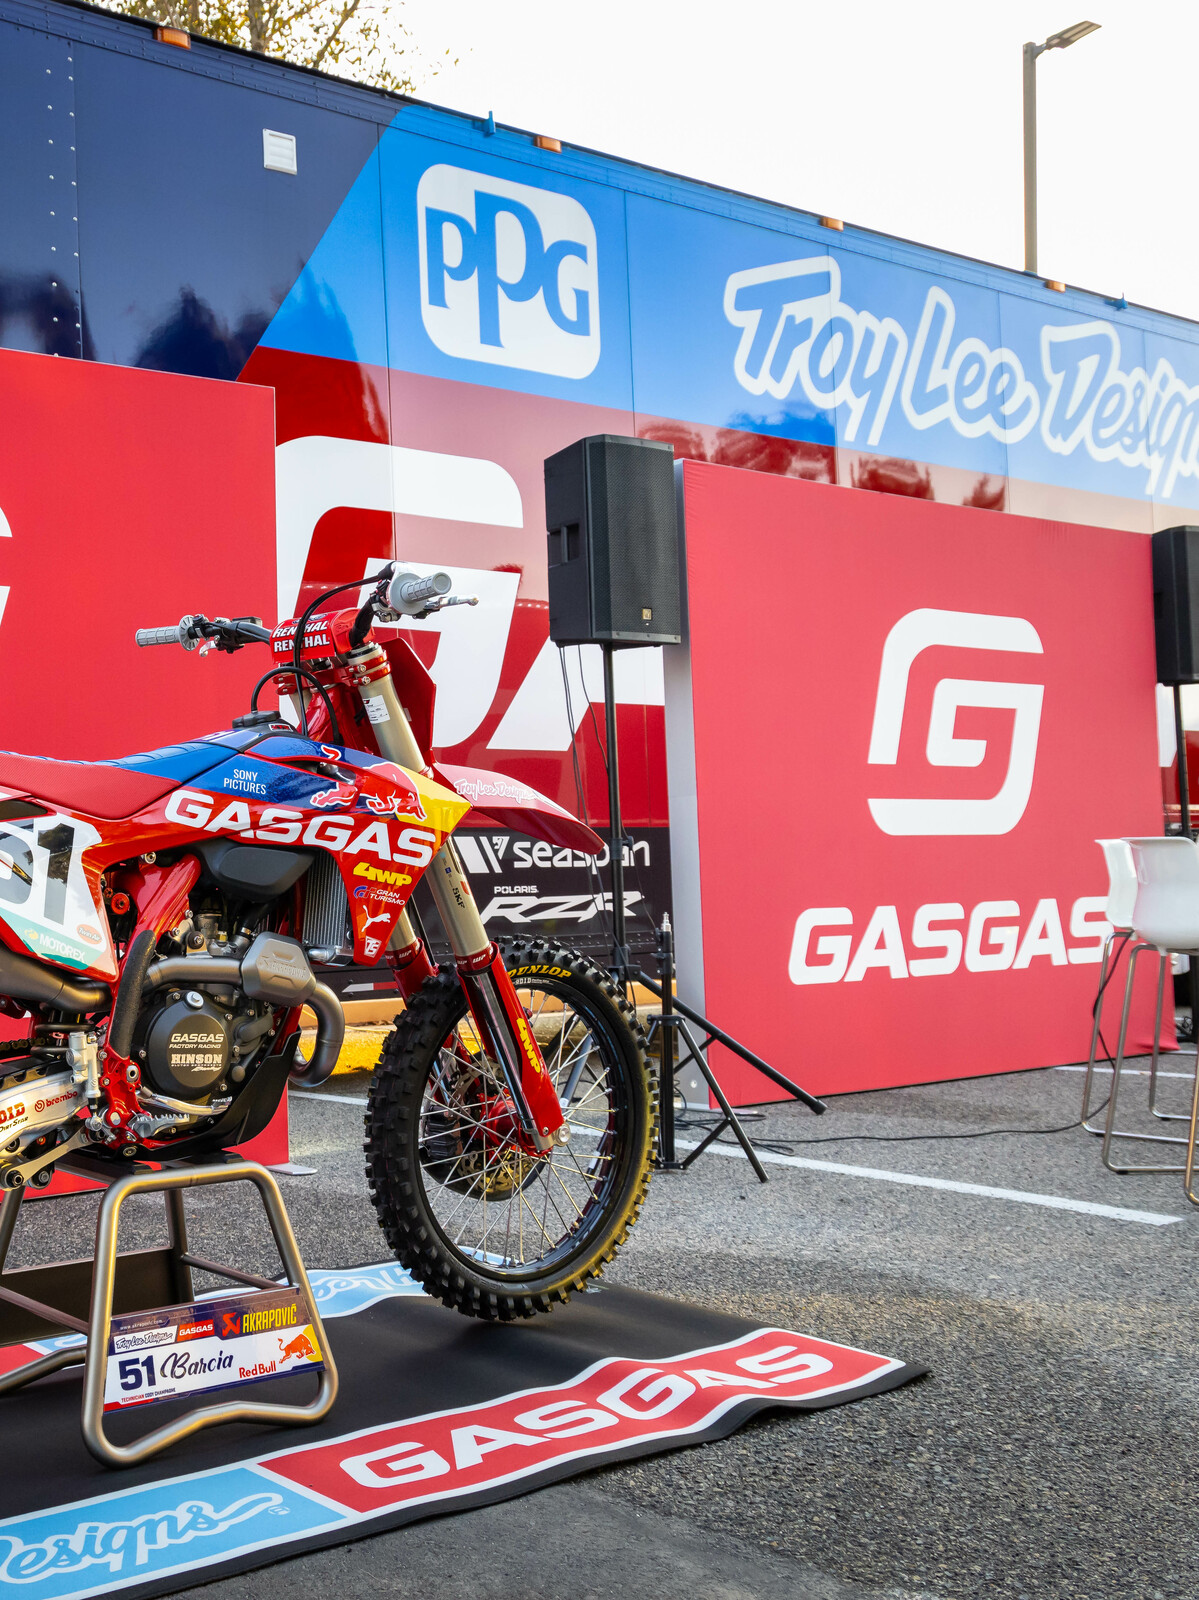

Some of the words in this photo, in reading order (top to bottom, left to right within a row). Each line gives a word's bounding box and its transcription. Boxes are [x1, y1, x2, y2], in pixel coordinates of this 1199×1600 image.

[724, 255, 908, 446] Troy
[902, 286, 1040, 444] Lee
[272, 621, 329, 638] RENHAL
[274, 634, 330, 652] RENHAL
[233, 768, 258, 781] SONY
[223, 778, 267, 795] PICTURES
[164, 790, 437, 868] GASGAS
[377, 889, 400, 898] GRAN
[494, 886, 538, 894] POLARIS
[370, 893, 406, 905] TURISMO
[39, 932, 86, 964] MOTOREX
[788, 896, 1114, 985] GASGAS
[171, 1033, 225, 1043] GASGAS
[171, 1053, 223, 1064] HINSON
[46, 1090, 78, 1107] brembo
[242, 1303, 298, 1334] AKRAPOVIČ
[179, 1323, 214, 1336] GASGAS
[119, 1355, 157, 1391] 51
[160, 1350, 234, 1379] Barcia
[238, 1363, 258, 1379] Red
[258, 1360, 277, 1375] Bull
[121, 1394, 145, 1403] TECHNICIAN
[340, 1345, 834, 1489] GASGAS
